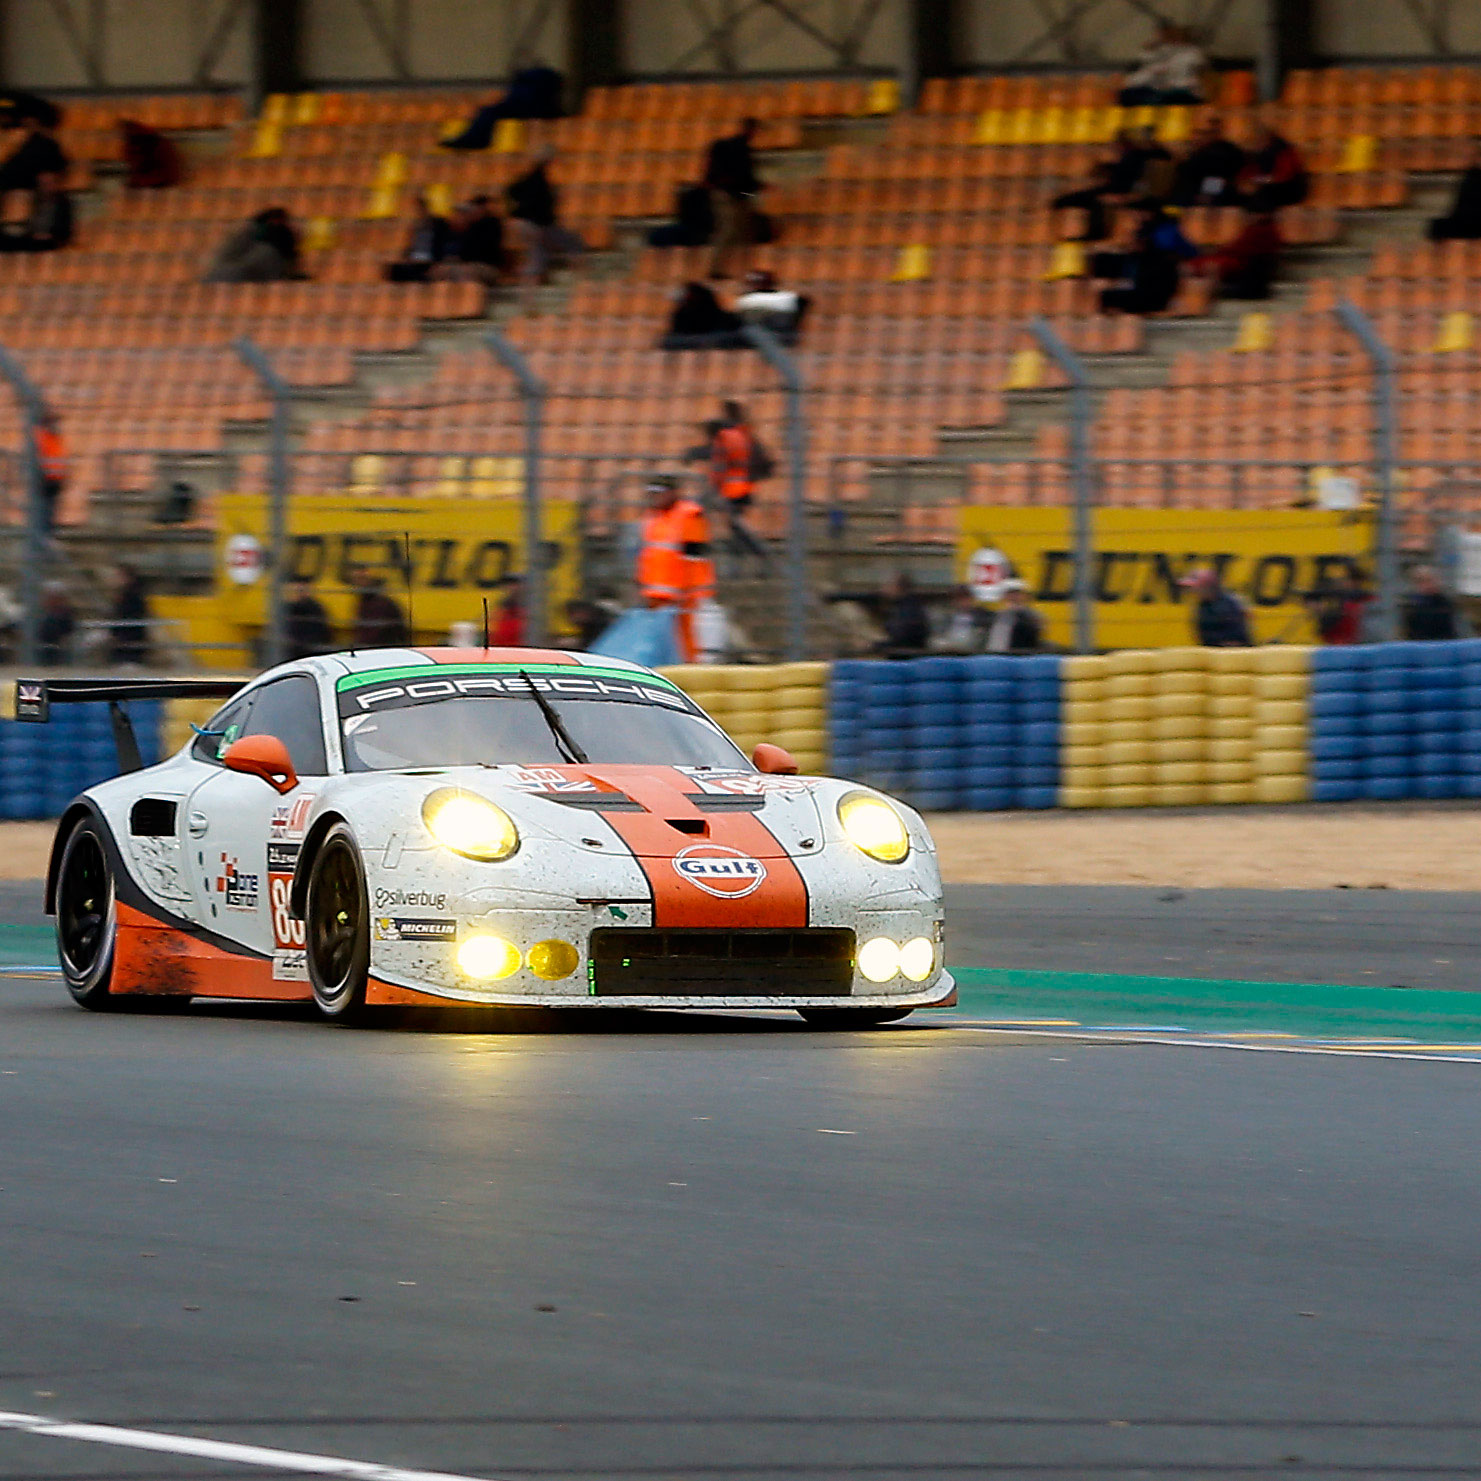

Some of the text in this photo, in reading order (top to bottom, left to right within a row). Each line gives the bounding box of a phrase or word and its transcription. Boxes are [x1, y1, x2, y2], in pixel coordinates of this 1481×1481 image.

[356, 677, 690, 710] PORSCHE
[679, 860, 759, 874] Gulf
[388, 888, 447, 910] silverbug
[400, 923, 456, 933] MICHELIN
